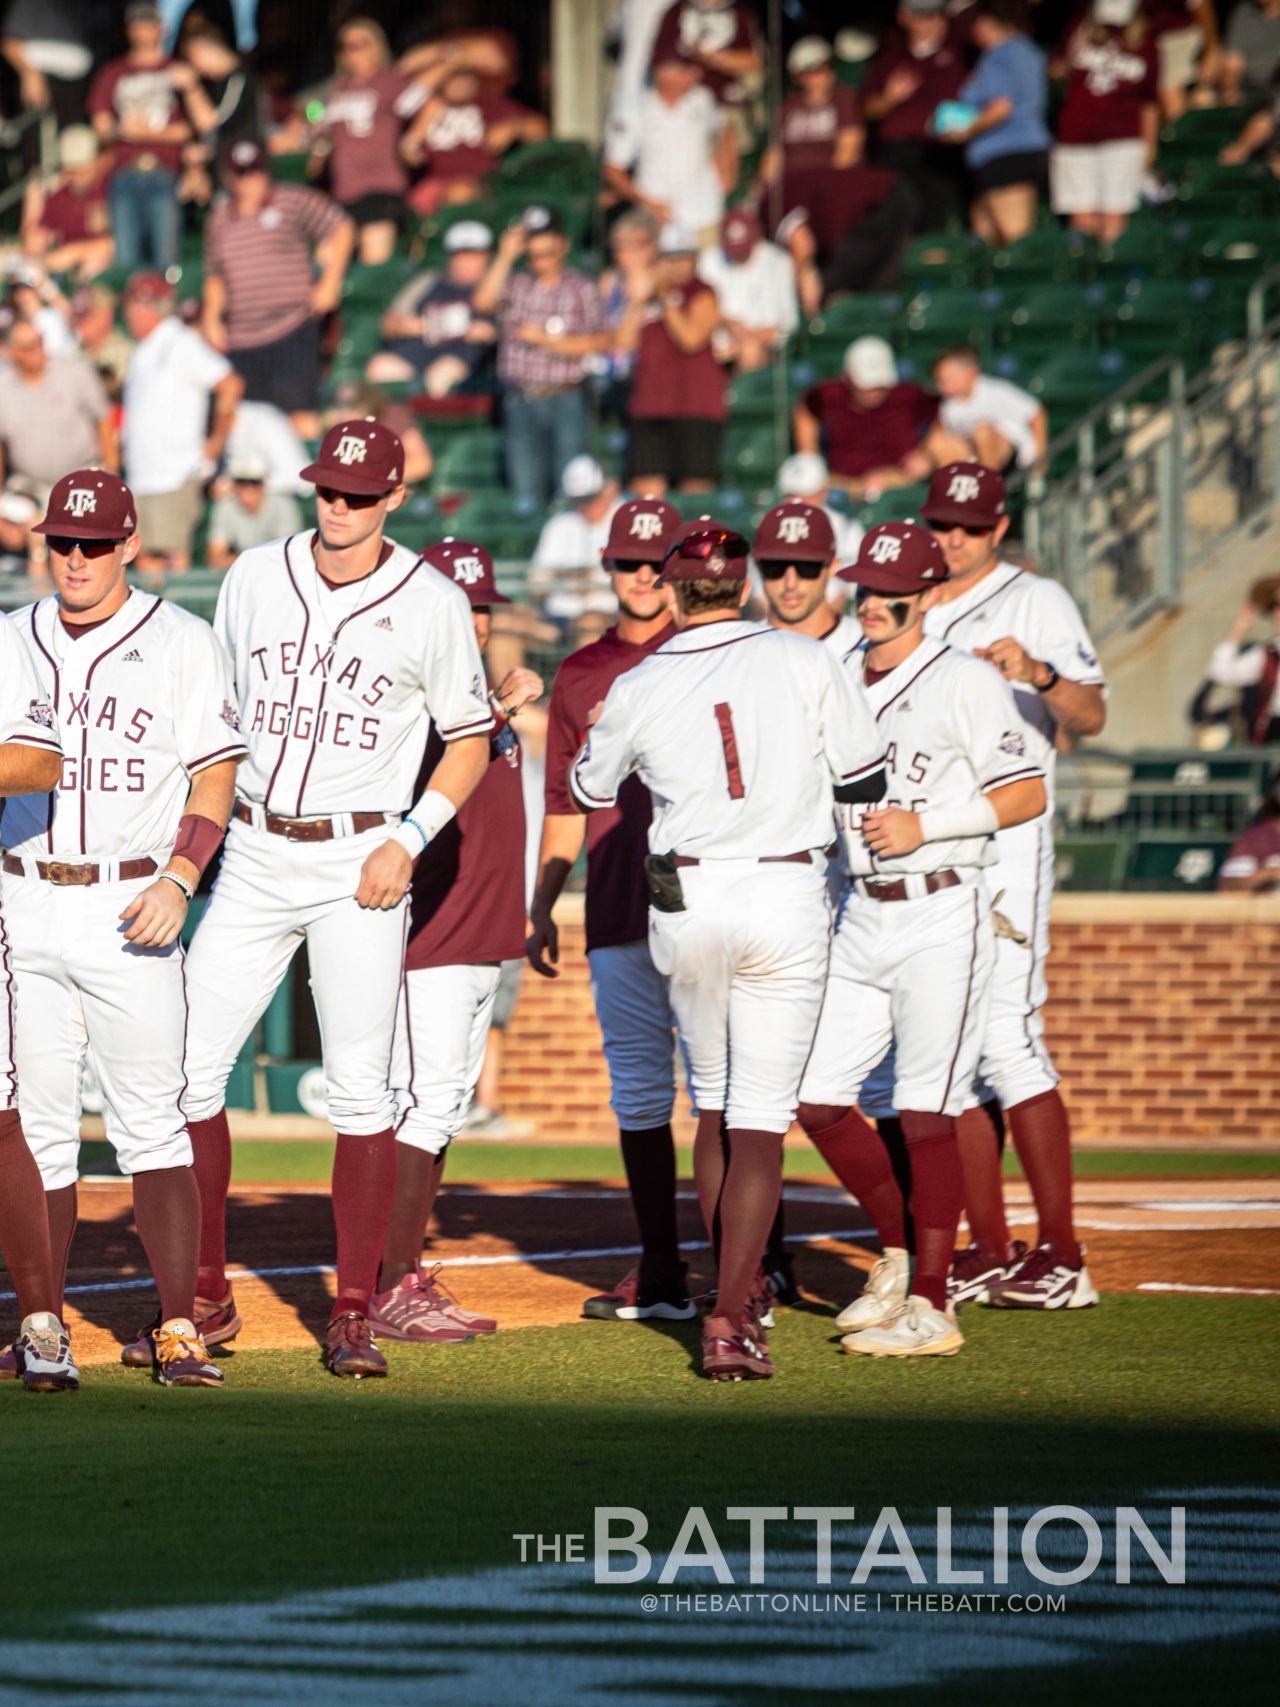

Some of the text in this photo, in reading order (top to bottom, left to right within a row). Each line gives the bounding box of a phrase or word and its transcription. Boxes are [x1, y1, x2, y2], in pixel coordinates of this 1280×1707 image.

[251, 641, 394, 707] TEXAS
[66, 692, 154, 744] XAS
[251, 699, 380, 751] AGGIES
[59, 758, 145, 792] GIES
[714, 701, 746, 801] 1
